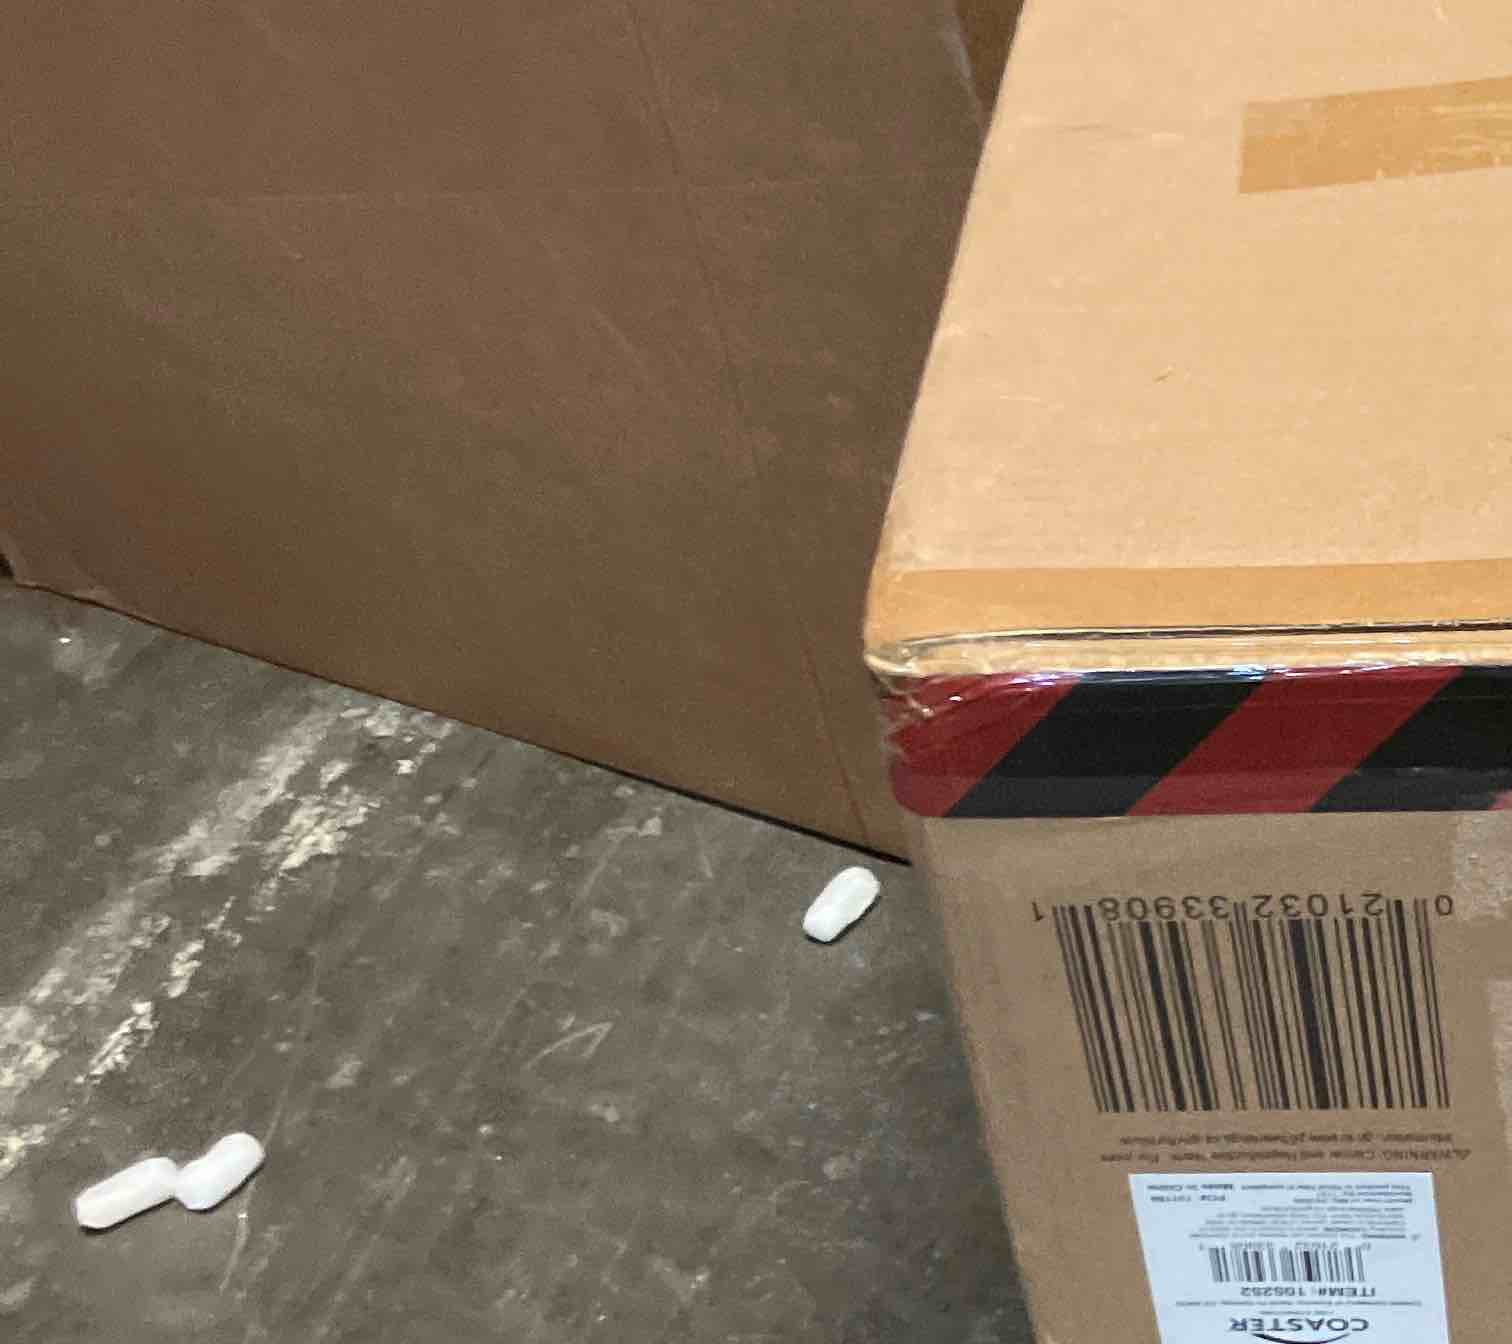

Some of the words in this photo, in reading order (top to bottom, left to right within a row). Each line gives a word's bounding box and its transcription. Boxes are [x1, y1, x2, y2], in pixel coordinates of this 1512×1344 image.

[1031, 901, 1045, 923] 1
[1097, 895, 1231, 922] 33908
[1253, 893, 1385, 919] 21032
[1435, 894, 1454, 917] 0
[1228, 1316, 1370, 1333] COASTER
